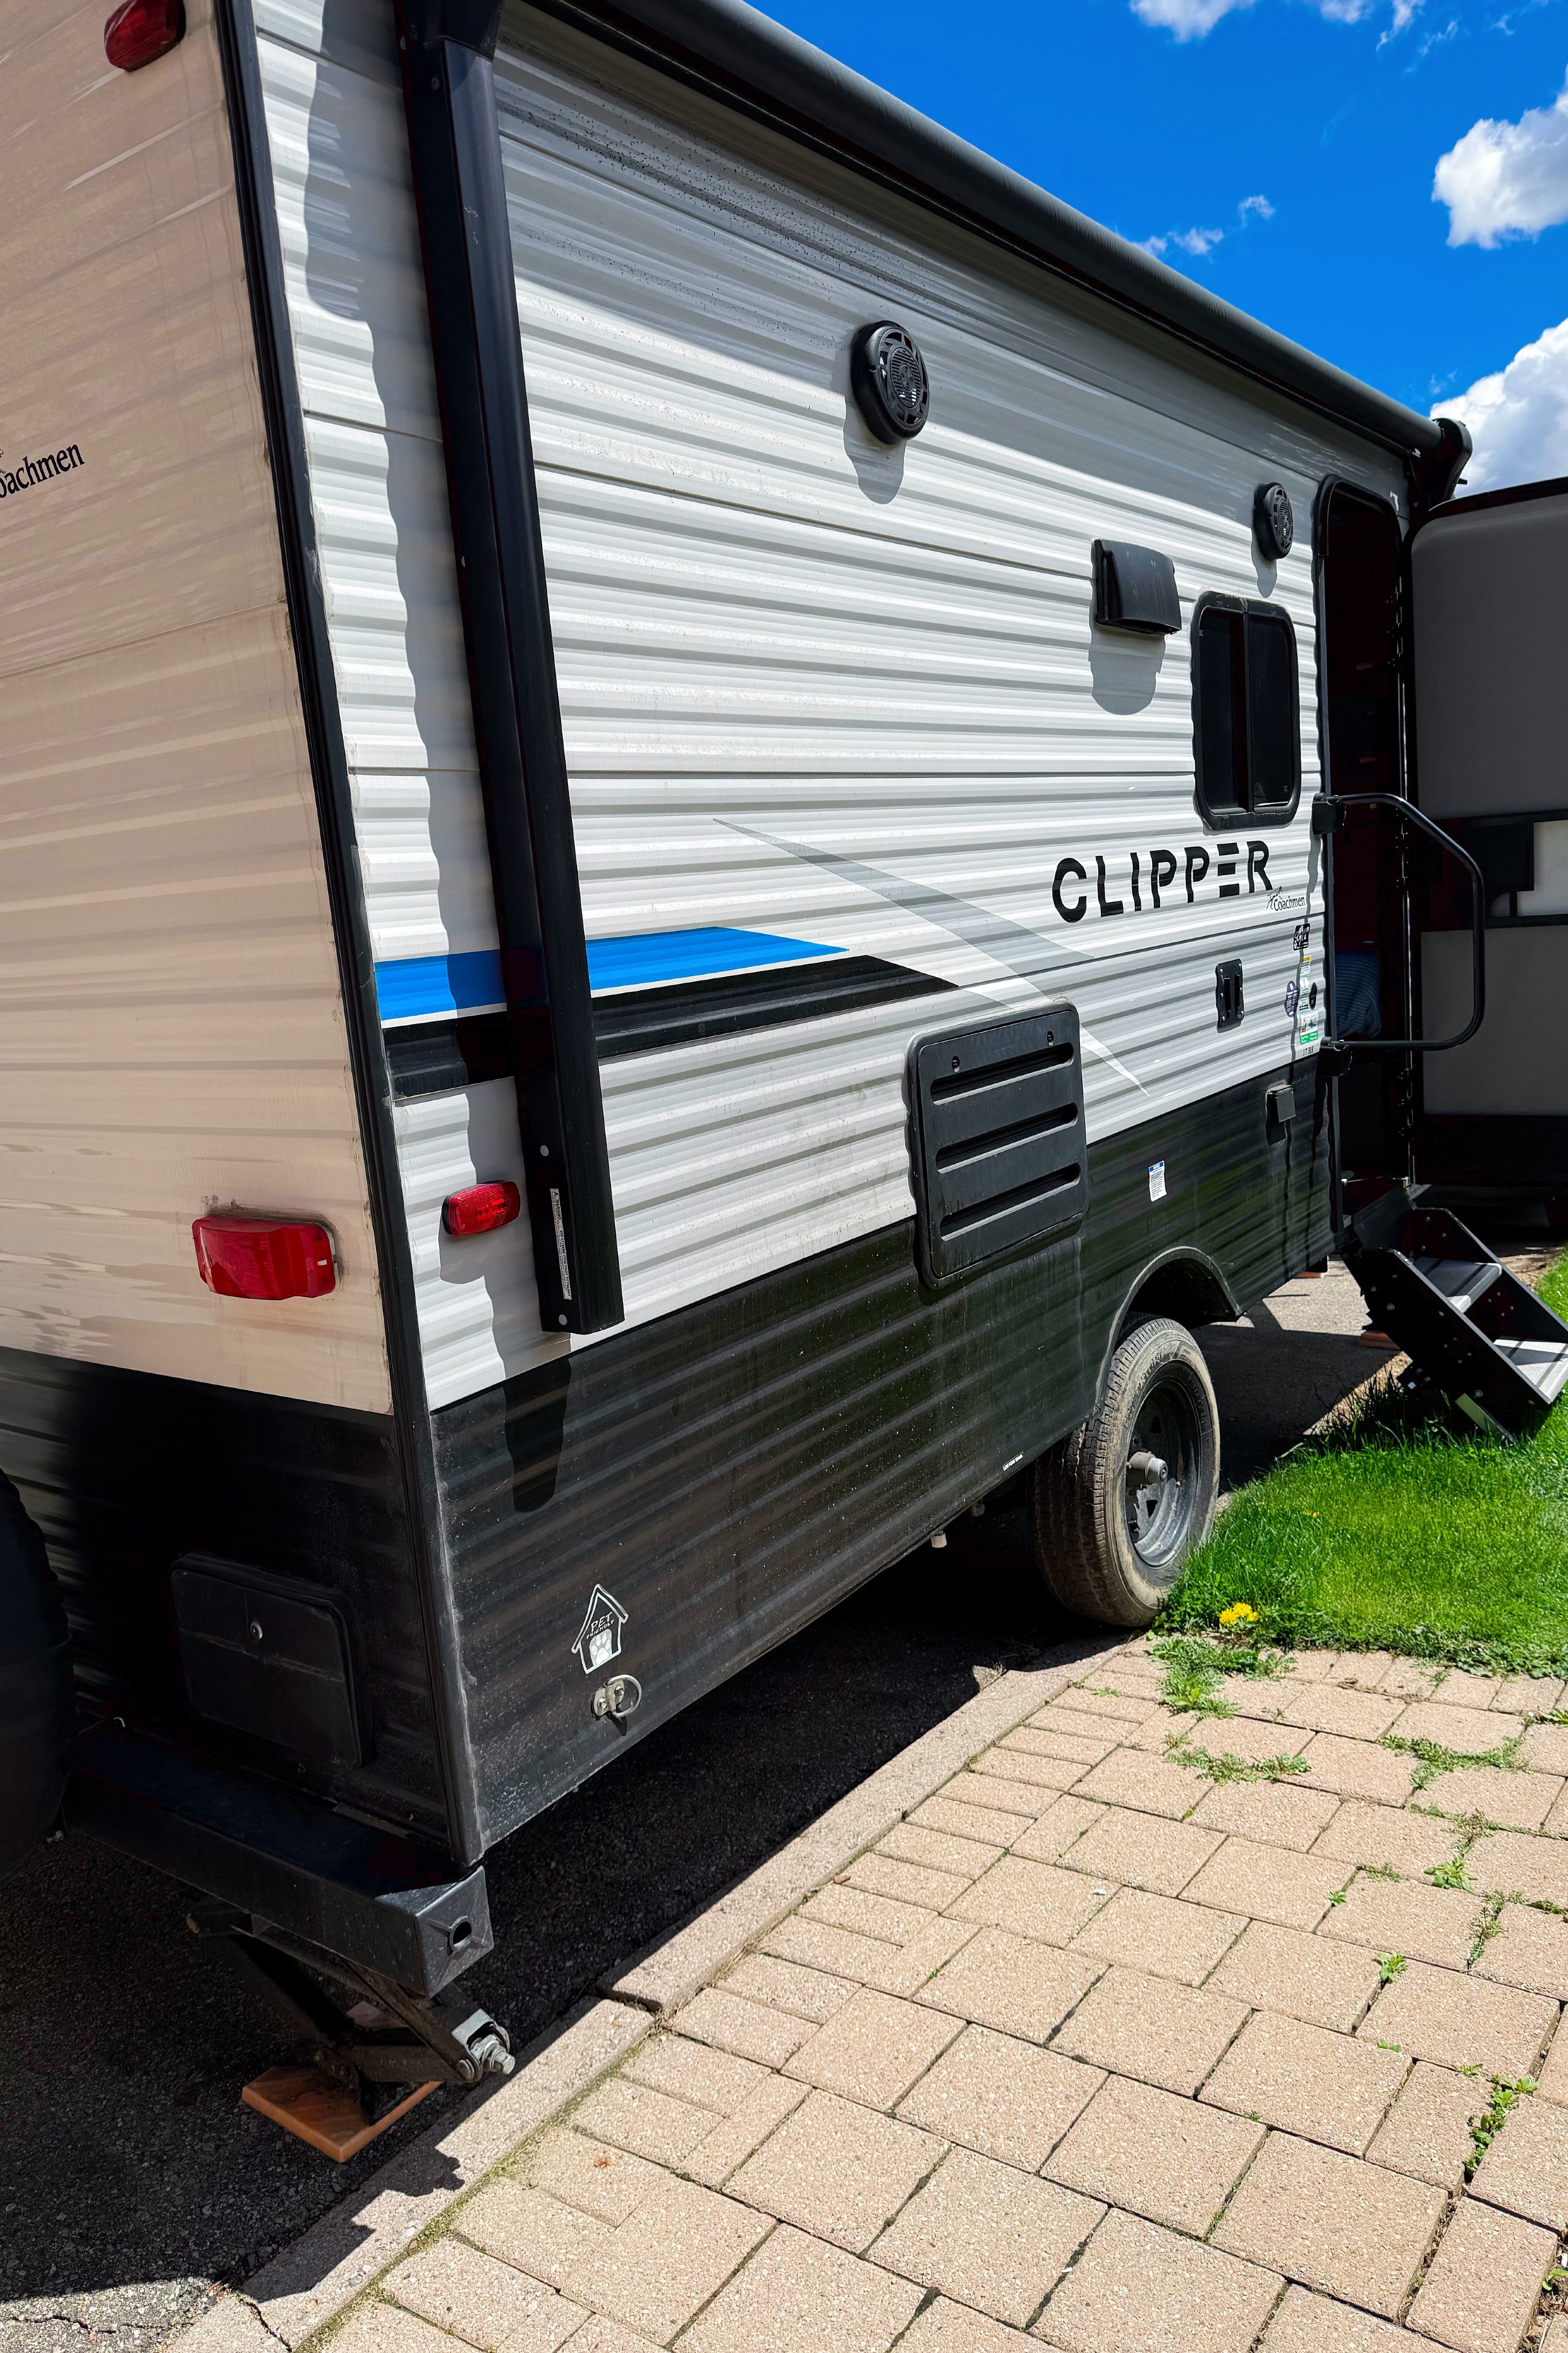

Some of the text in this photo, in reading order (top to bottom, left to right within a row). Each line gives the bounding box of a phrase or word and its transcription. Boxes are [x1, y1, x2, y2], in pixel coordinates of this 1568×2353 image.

[1052, 840, 1274, 923] CLIPPER
[1274, 895, 1306, 911] Coachmen
[591, 1612, 613, 1633] PET
